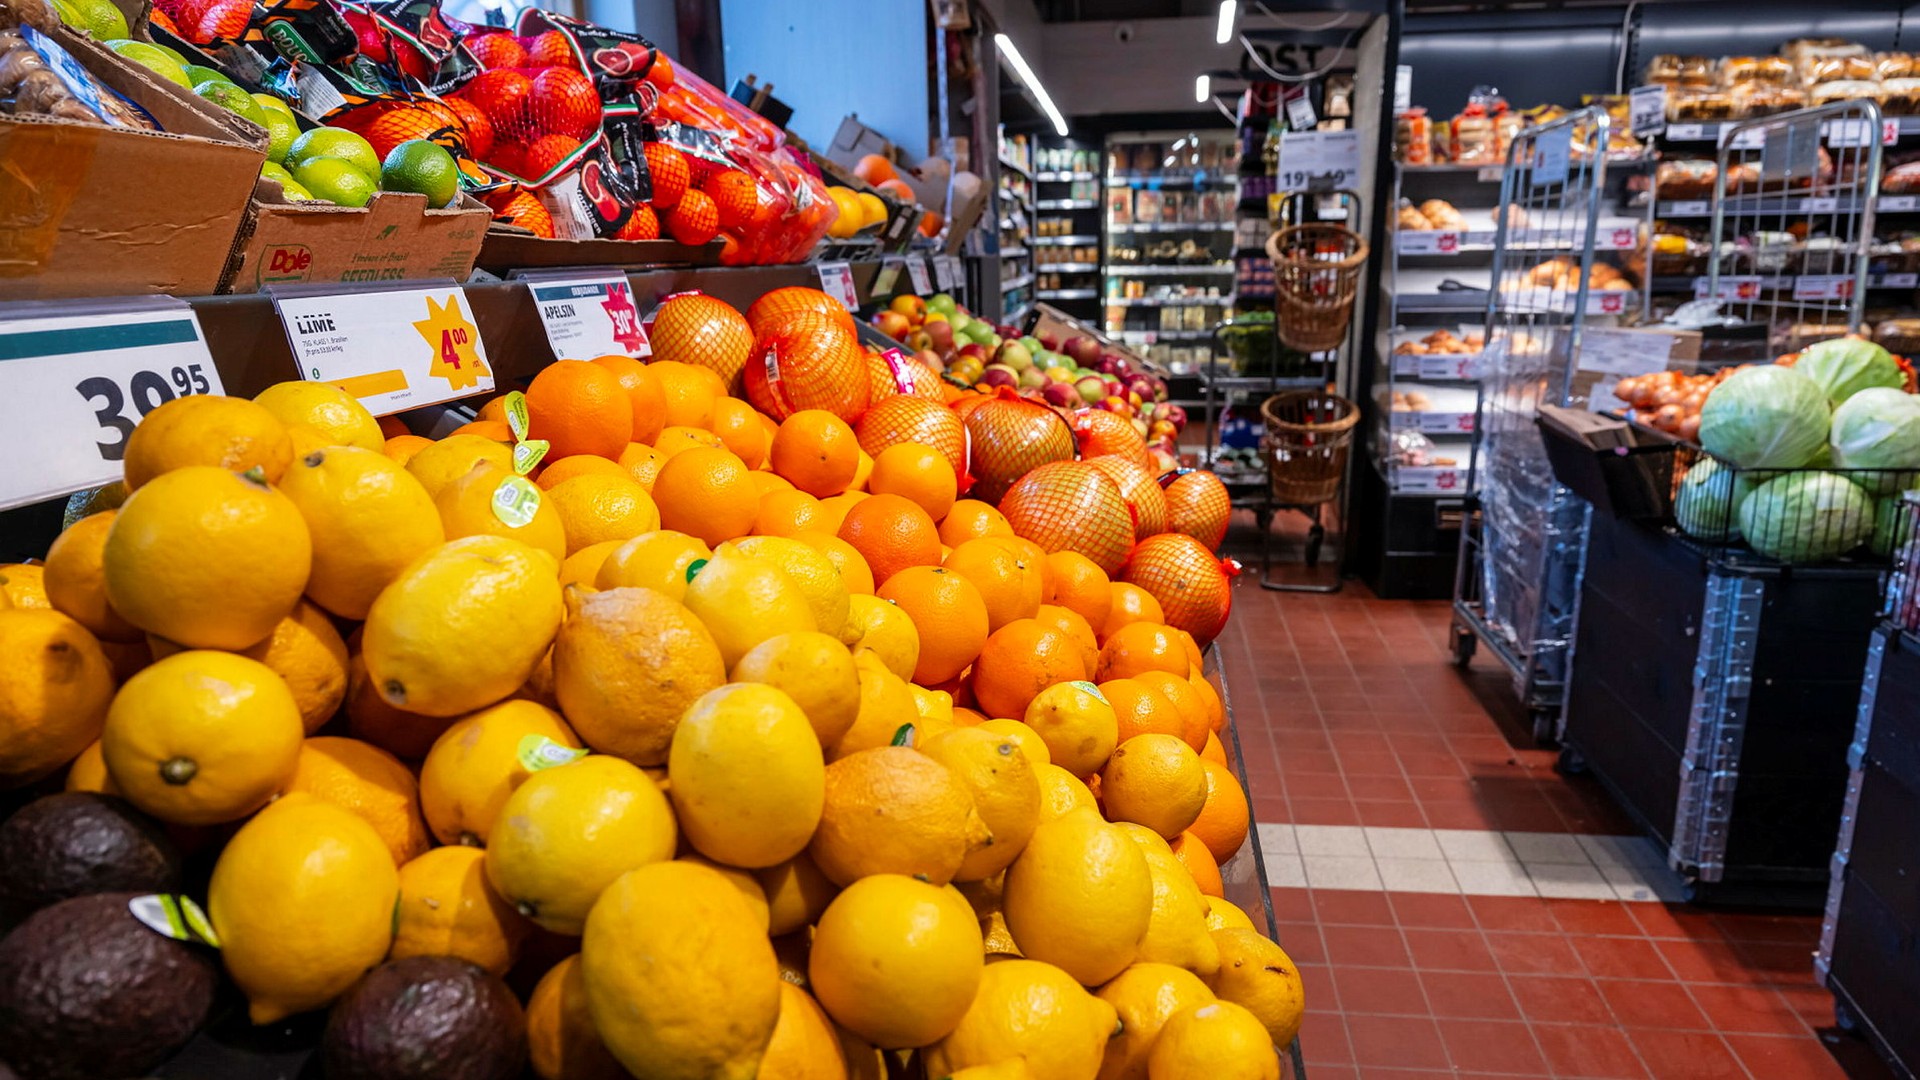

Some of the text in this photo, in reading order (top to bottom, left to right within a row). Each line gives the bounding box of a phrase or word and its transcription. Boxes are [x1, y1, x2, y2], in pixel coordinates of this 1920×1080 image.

[269, 248, 311, 273] Dole
[544, 304, 576, 320] APELSIN
[294, 313, 336, 334] LIME
